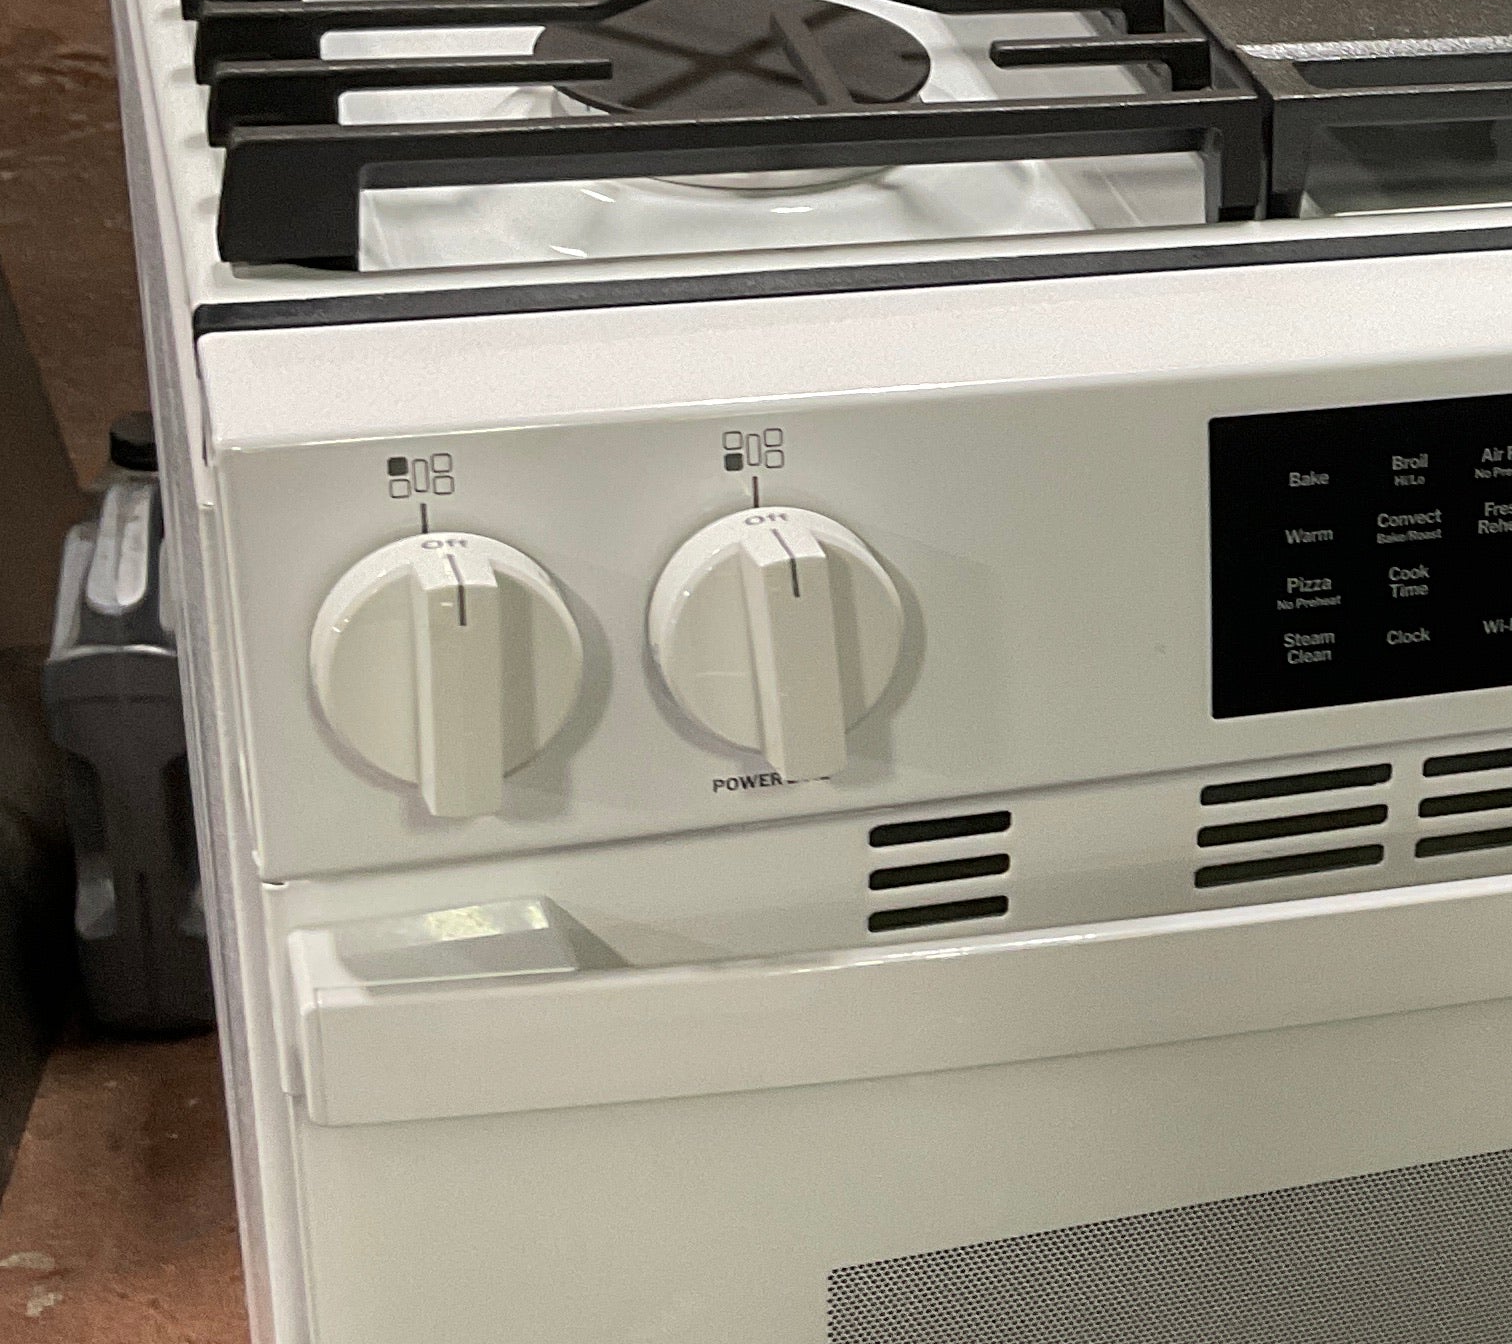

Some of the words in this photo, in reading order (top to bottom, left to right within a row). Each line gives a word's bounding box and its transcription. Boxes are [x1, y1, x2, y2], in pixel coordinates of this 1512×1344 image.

[1391, 453, 1429, 471] Broil
[1481, 447, 1505, 463] Air
[1288, 470, 1330, 487] Bake
[1376, 508, 1443, 528] Convect
[1284, 529, 1334, 545] Warm
[1388, 564, 1430, 581] Cook
[1286, 576, 1332, 594] Pizza
[1389, 583, 1429, 599] Time
[1283, 632, 1336, 648] Steam
[1386, 627, 1431, 645] Clock
[1287, 649, 1332, 665] Clean
[712, 772, 783, 793] POWER
